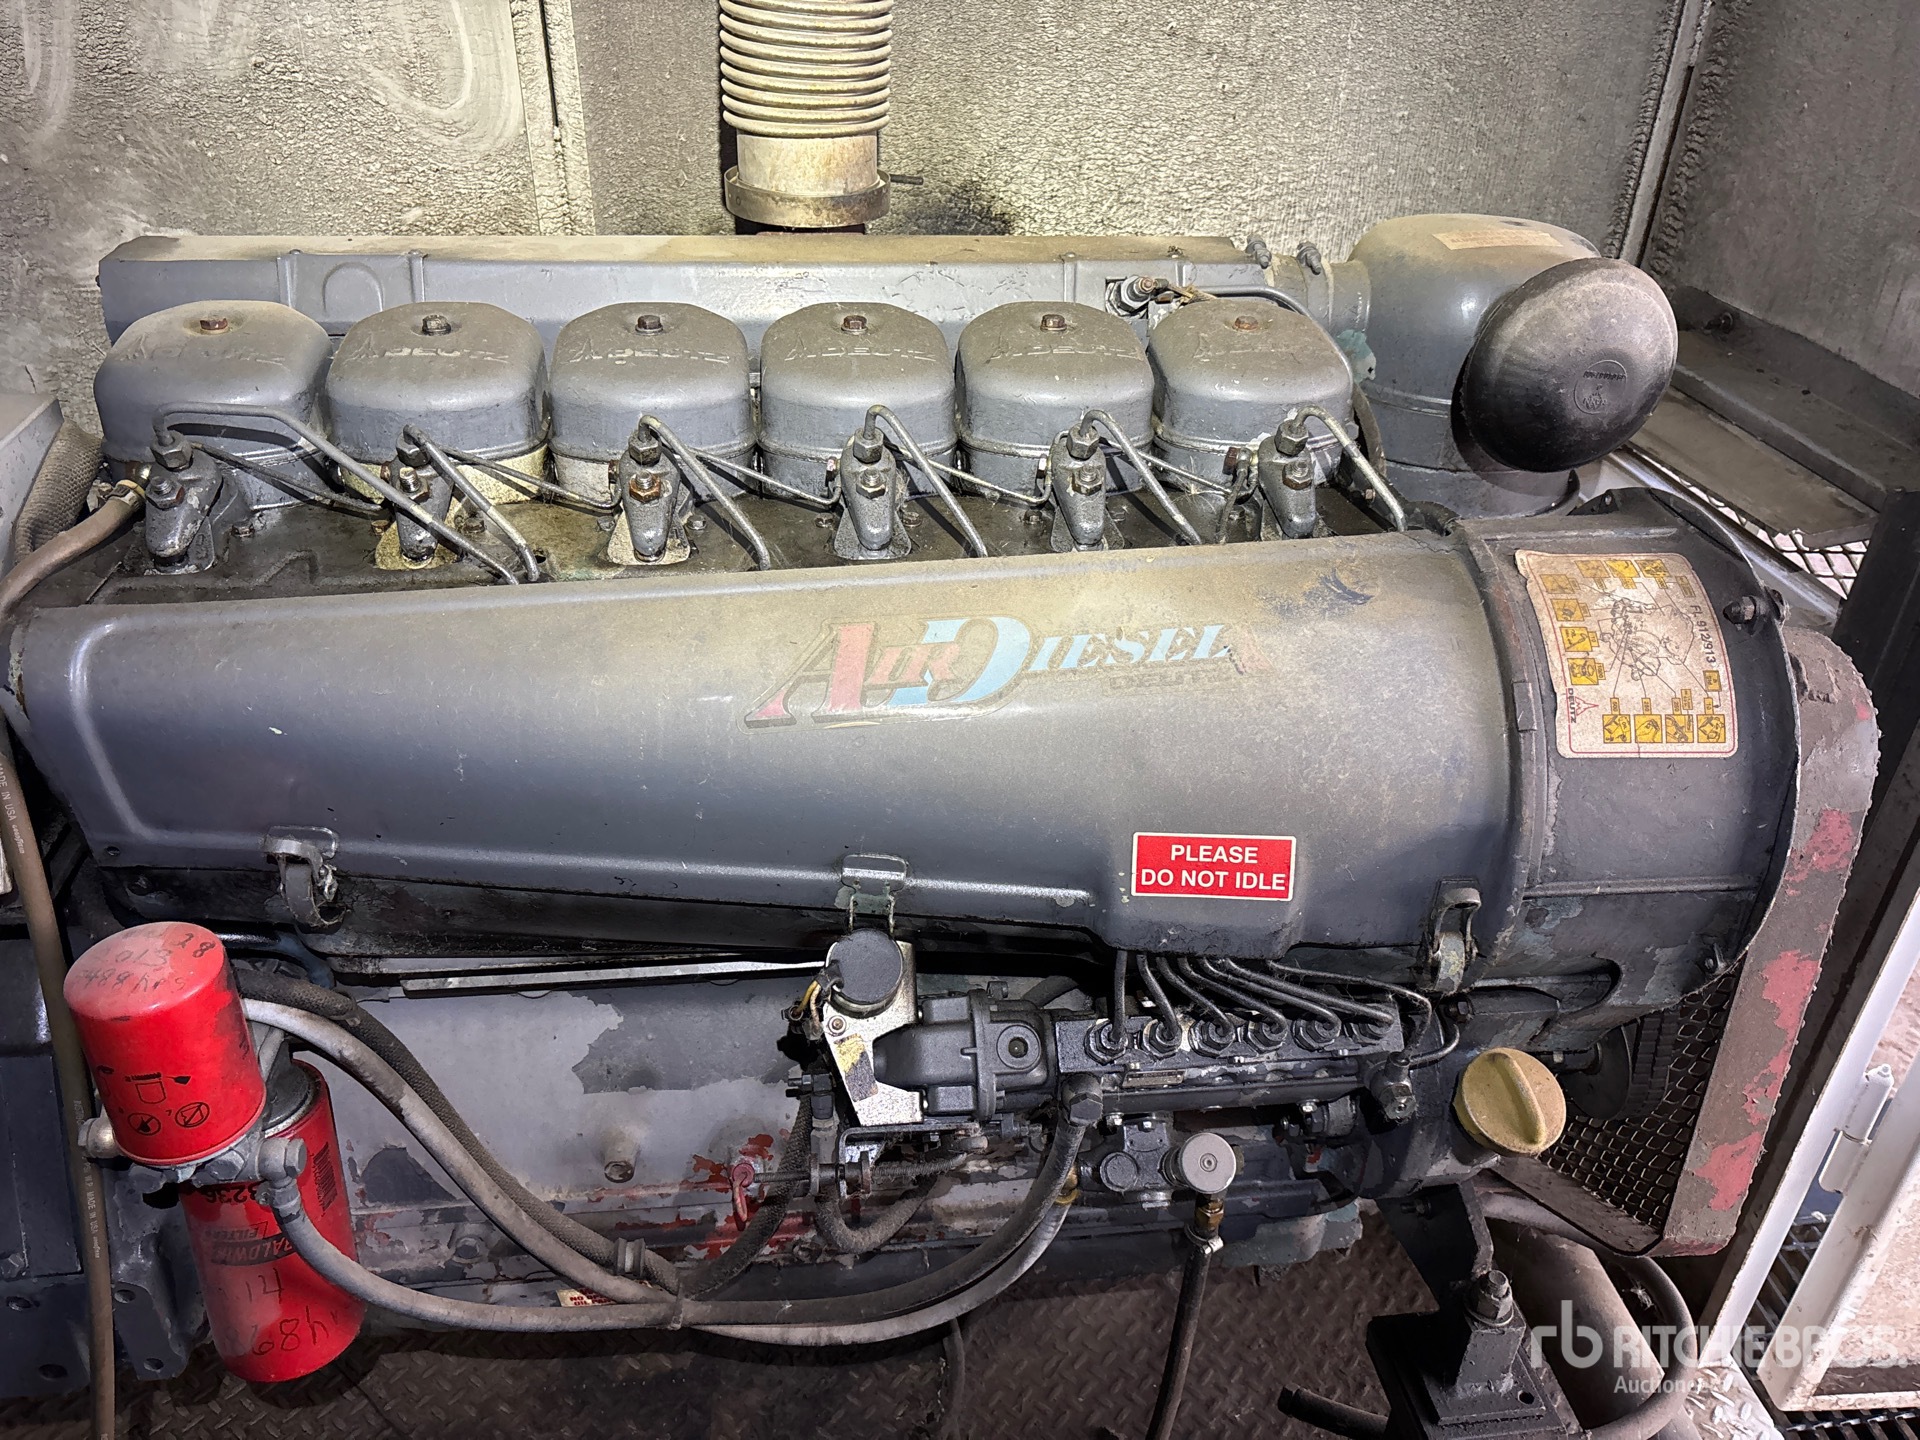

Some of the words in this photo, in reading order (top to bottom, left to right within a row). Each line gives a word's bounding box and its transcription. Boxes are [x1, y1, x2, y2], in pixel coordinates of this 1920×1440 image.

[1690, 605, 1703, 618] FL
[1696, 620, 1717, 664] 912/913
[1567, 687, 1577, 724] DEUTZ
[5, 803, 17, 821] USA
[1171, 844, 1259, 864] PLEASE
[1141, 868, 1174, 887] DO
[1181, 869, 1229, 888] NOT
[1235, 871, 1286, 891] IDLE
